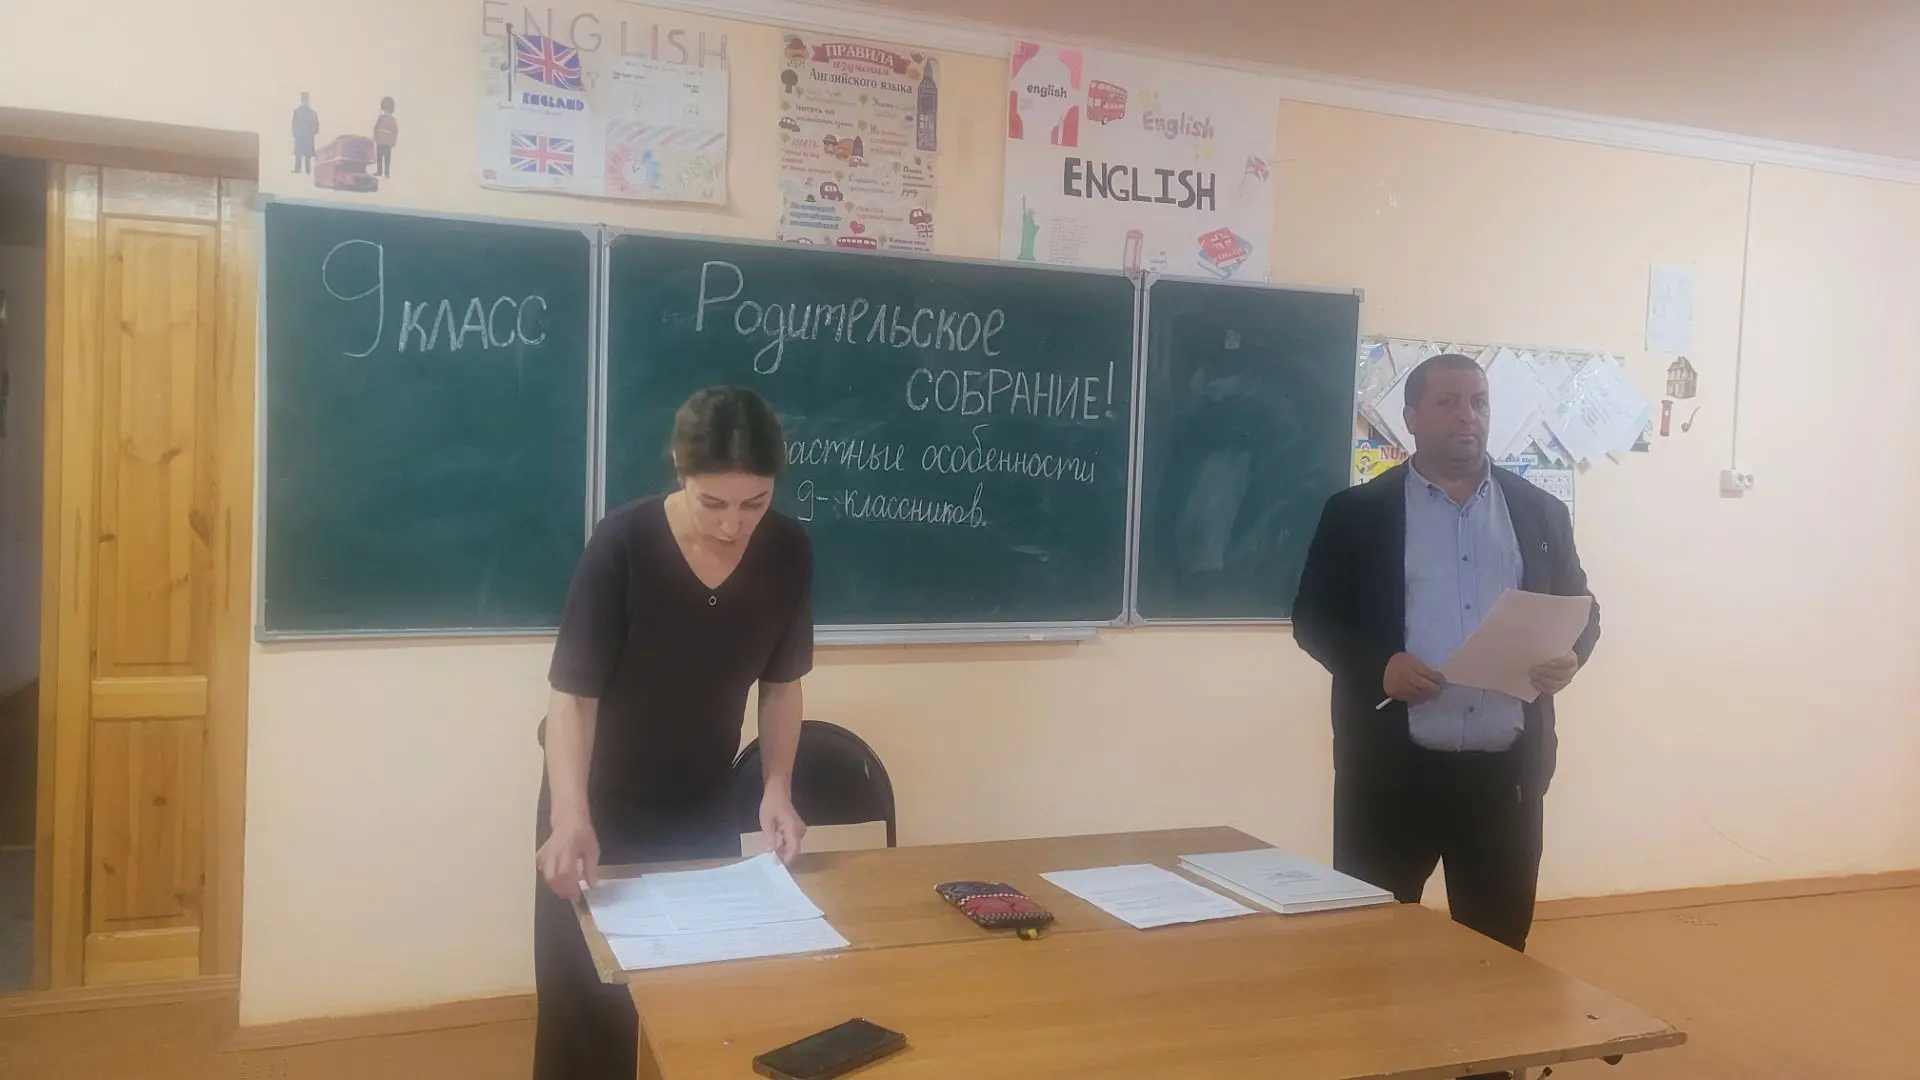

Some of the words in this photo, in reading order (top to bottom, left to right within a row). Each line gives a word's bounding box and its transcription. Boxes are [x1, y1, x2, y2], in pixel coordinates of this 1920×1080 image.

[482, 0, 728, 73] ENGLISH
[824, 43, 895, 67] ПРАВИЛА
[522, 92, 585, 112] ENGLAND
[808, 68, 878, 89] Английского
[880, 81, 913, 94] языка
[1026, 82, 1068, 99] english
[1142, 110, 1215, 141] English
[1063, 156, 1217, 212] ENGLISH
[322, 238, 385, 358] 9
[695, 260, 1005, 375] Родительское
[906, 360, 1116, 420] СОБРАНИЕ!
[783, 436, 905, 473] астные
[921, 423, 1100, 483] особенности
